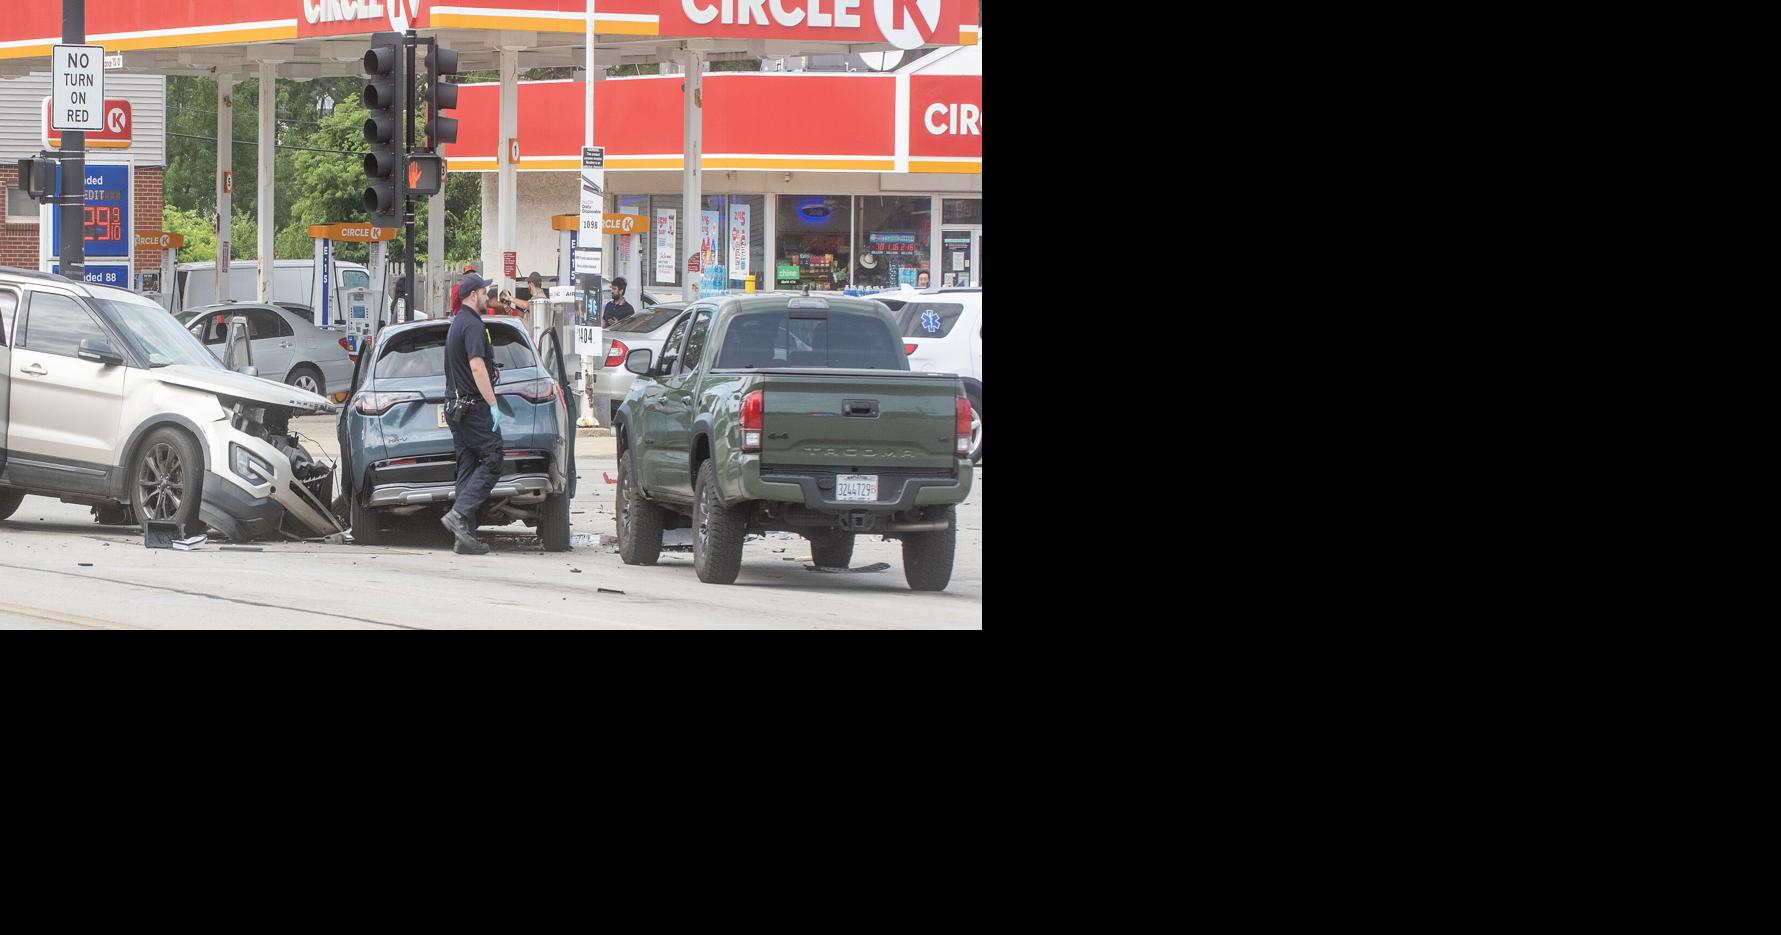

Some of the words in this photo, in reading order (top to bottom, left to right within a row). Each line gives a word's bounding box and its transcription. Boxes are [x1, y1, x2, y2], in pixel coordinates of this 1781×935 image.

[681, 0, 861, 28] CIRCLE
[68, 53, 90, 69] NO
[64, 73, 94, 87] TURN
[71, 91, 86, 105] ON
[67, 109, 89, 123] RED
[110, 110, 125, 131] K
[924, 102, 982, 135] CIR
[84, 176, 103, 185] ded
[341, 228, 369, 237] CIRCLE
[84, 272, 103, 282] ded
[105, 272, 117, 282] 88
[803, 447, 916, 458] TACOMA
